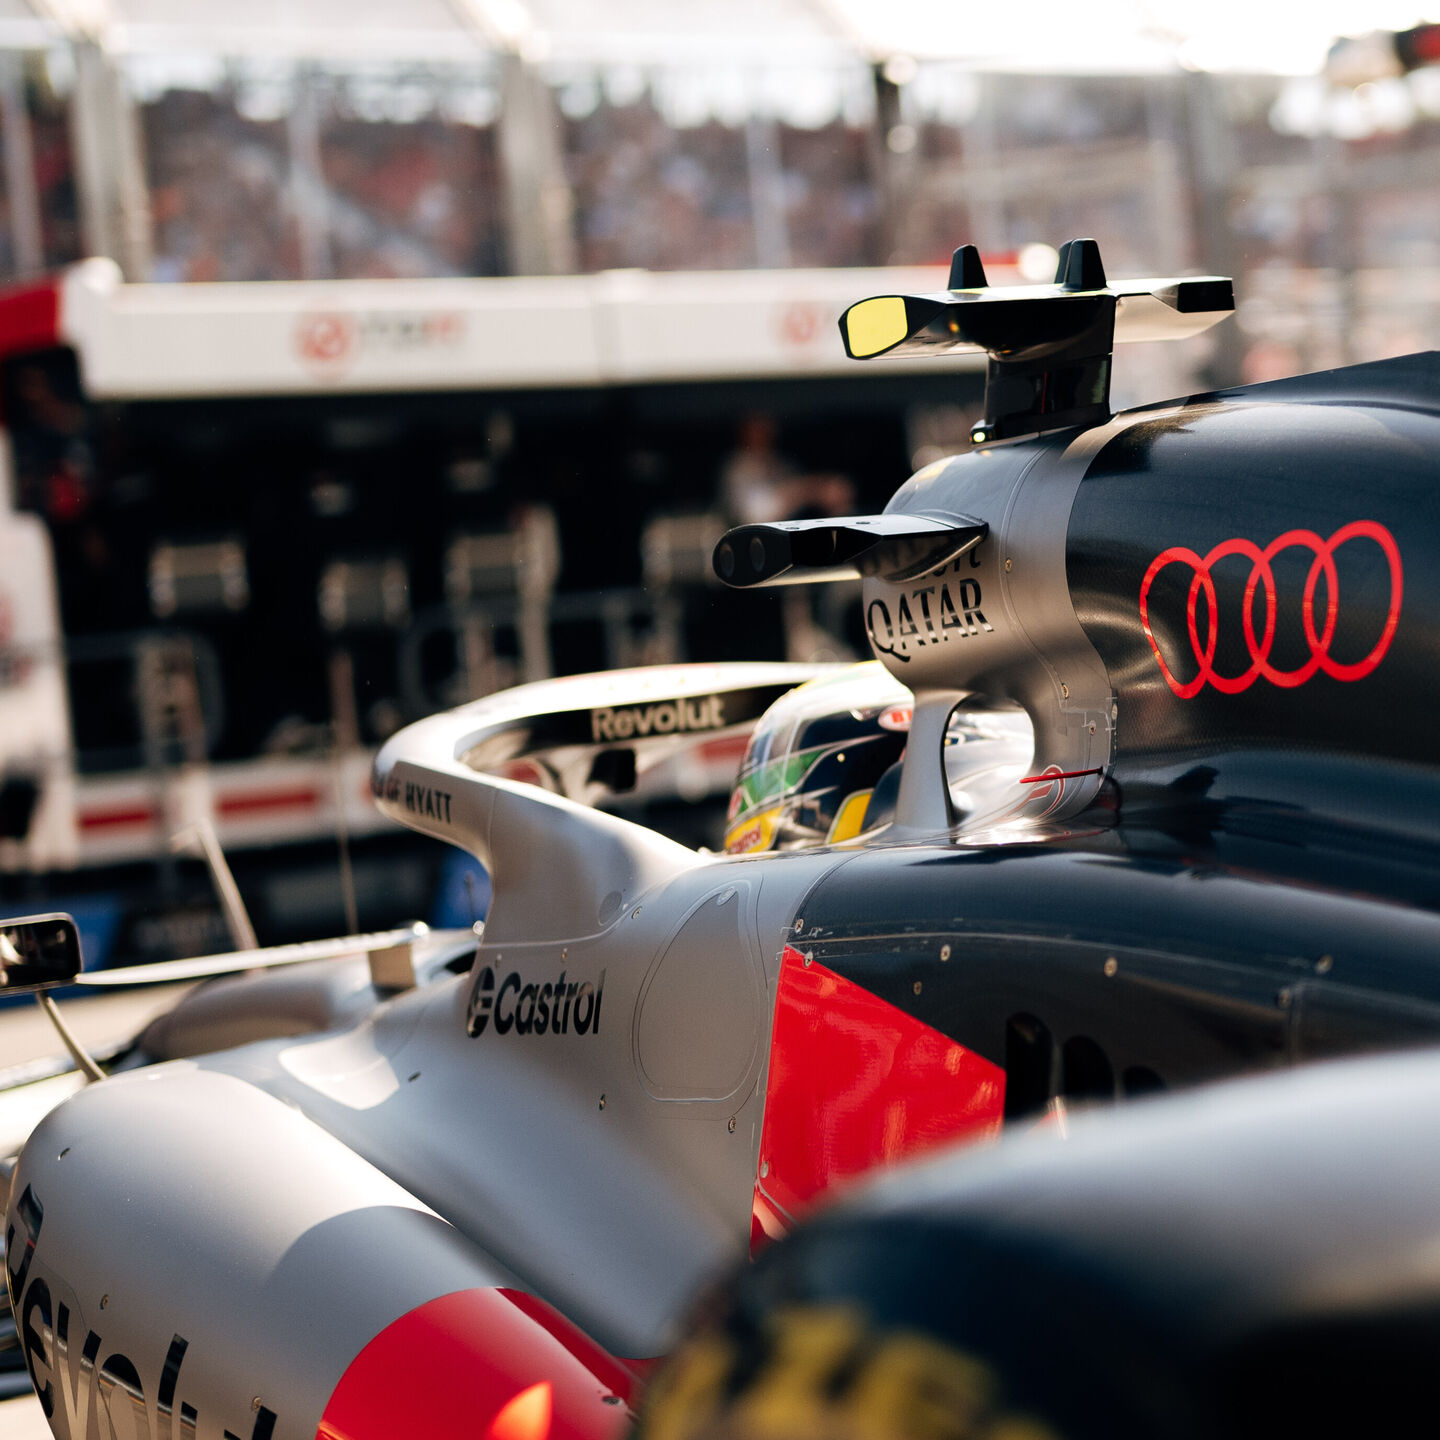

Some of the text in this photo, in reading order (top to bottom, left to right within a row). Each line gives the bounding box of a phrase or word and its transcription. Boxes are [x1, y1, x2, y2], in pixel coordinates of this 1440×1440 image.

[867, 577, 994, 662] QATAR
[591, 695, 725, 741] Revolut
[405, 781, 451, 824] HYATT
[494, 967, 606, 1035] Castrol
